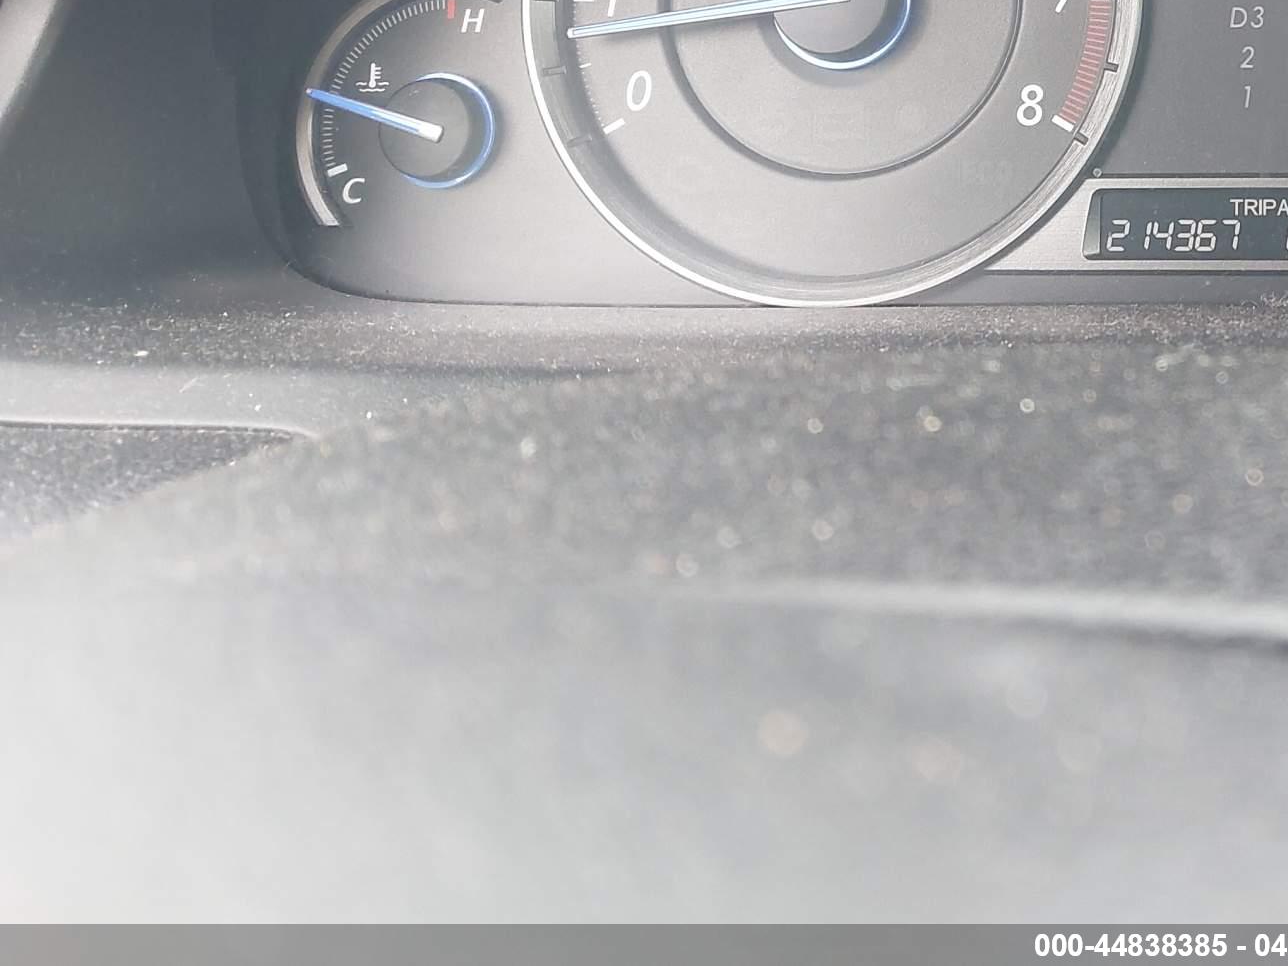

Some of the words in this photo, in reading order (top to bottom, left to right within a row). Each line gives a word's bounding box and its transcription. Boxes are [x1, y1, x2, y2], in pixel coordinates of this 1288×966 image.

[461, 8, 485, 33] H
[1229, 7, 1265, 29] D3
[1240, 47, 1255, 68] 2
[626, 70, 652, 111] 0
[1243, 86, 1252, 108] 1
[1017, 85, 1044, 125] 8
[342, 178, 365, 204] C
[1106, 219, 1241, 252] 214367
